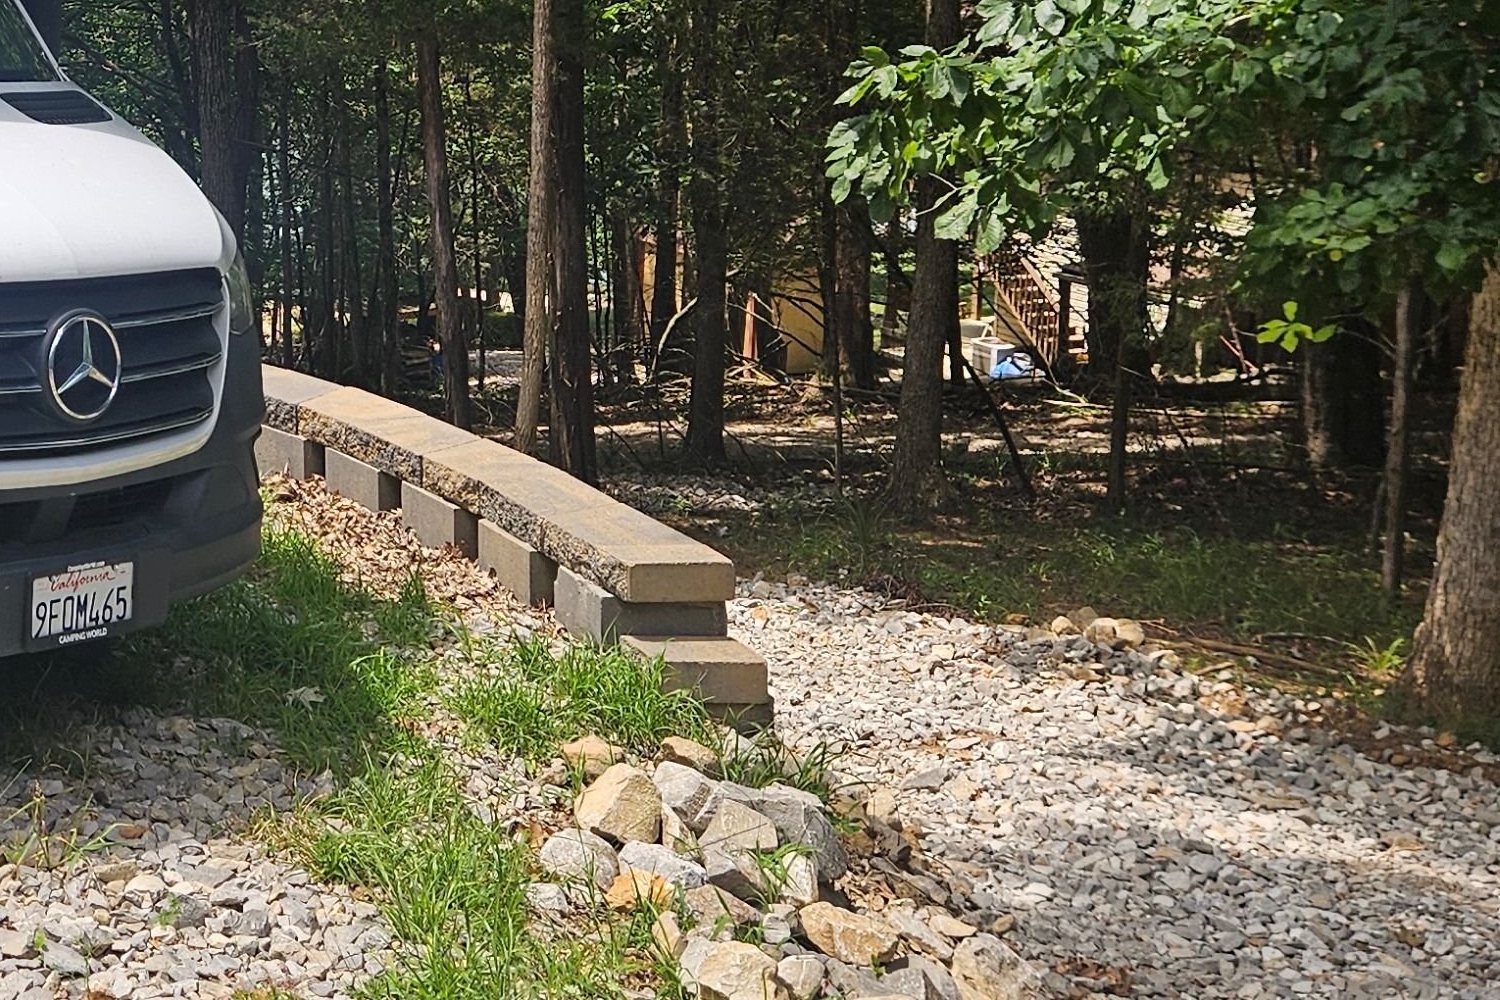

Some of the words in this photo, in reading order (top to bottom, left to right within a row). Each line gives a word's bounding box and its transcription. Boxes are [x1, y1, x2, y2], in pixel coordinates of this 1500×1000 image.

[50, 569, 116, 593] California
[58, 630, 86, 645] CAMPING
[85, 627, 108, 639] WORLD
